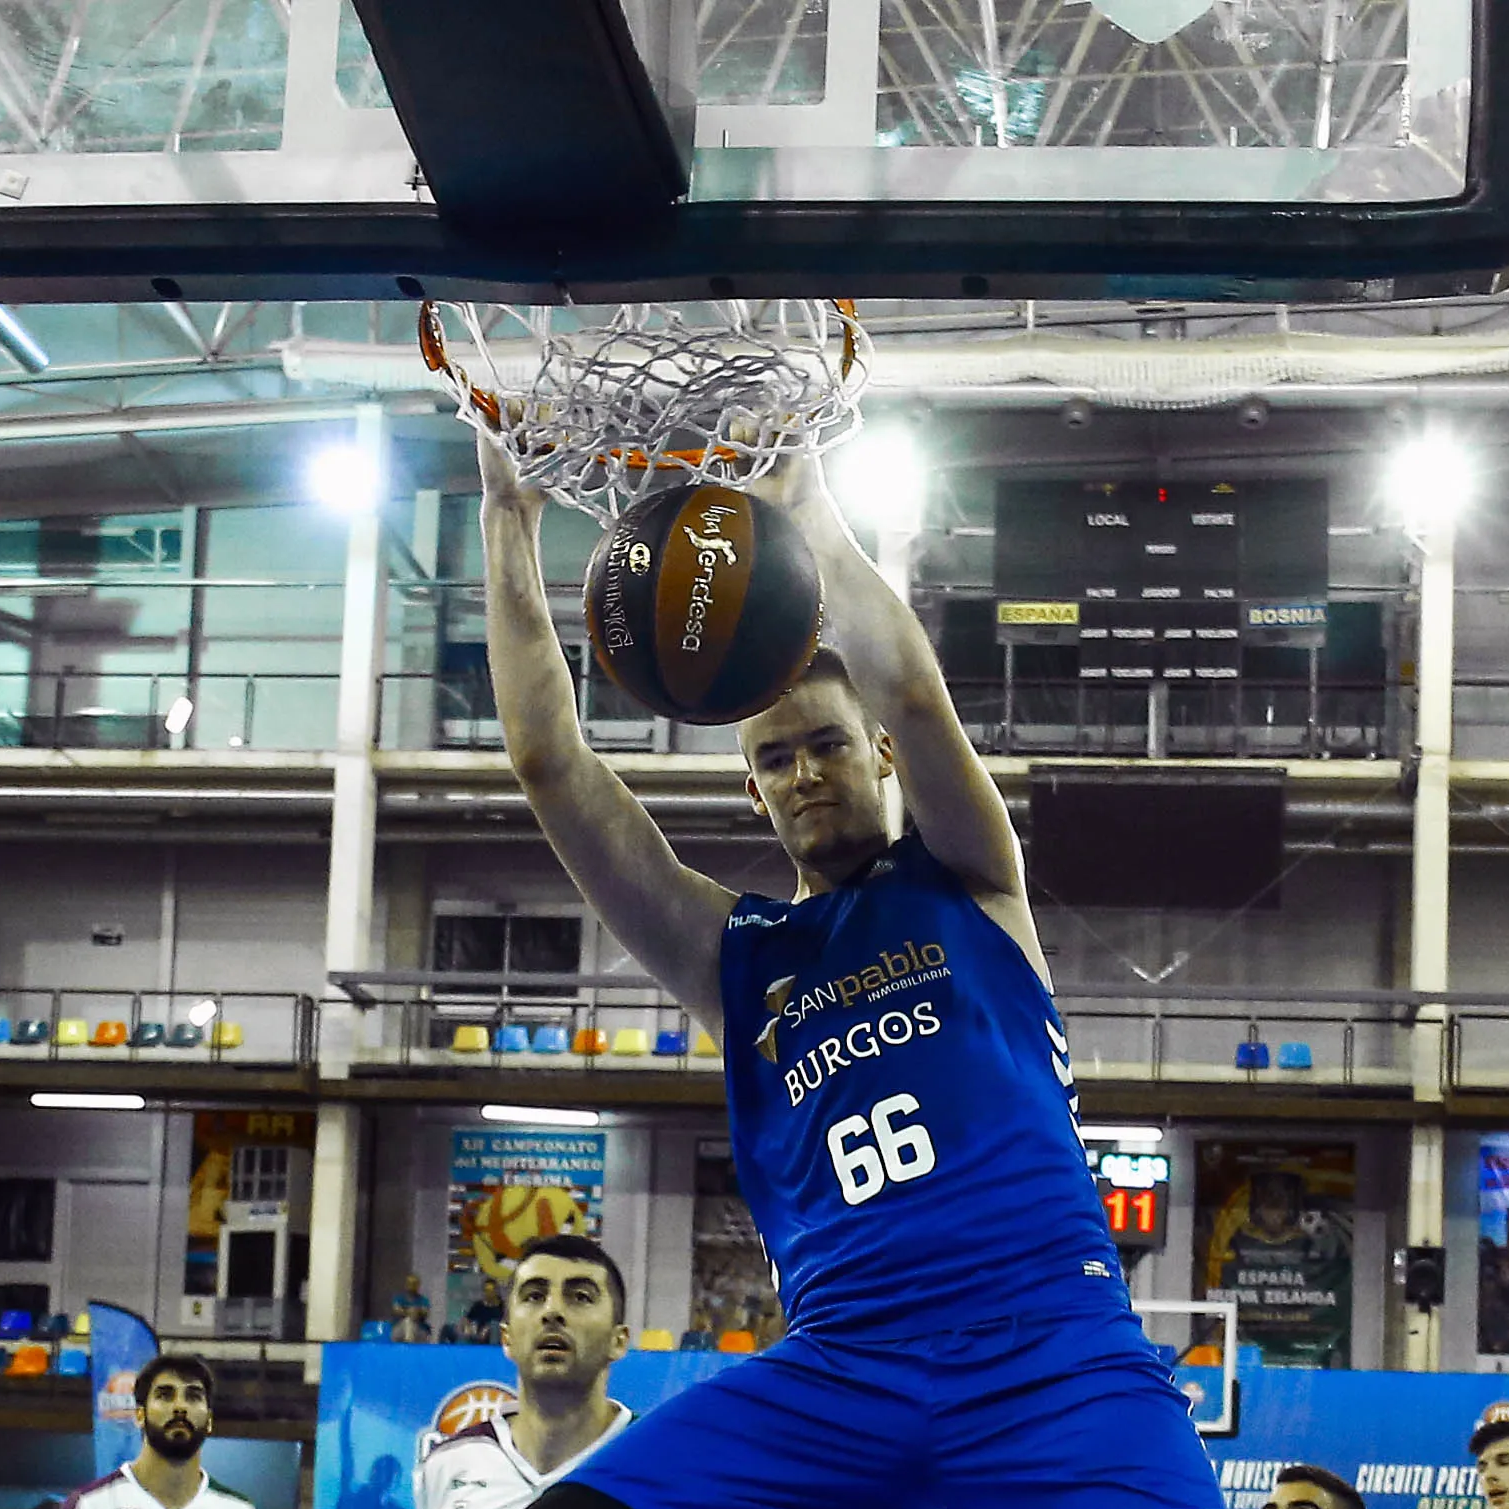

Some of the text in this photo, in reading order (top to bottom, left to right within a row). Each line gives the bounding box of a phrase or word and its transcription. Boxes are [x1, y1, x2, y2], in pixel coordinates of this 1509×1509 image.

[1087, 513, 1129, 526] LOCAL
[1002, 606, 1074, 622] ESPAÑA
[1249, 608, 1327, 625] BOSNIA
[867, 966, 952, 1003] INMOBILIARIA
[784, 1001, 941, 1107] BURGOS
[827, 1093, 936, 1206] 66
[1103, 1188, 1156, 1233] 11
[1238, 1267, 1306, 1286] ESPAÑA
[1356, 1464, 1433, 1495] CIRCUITO
